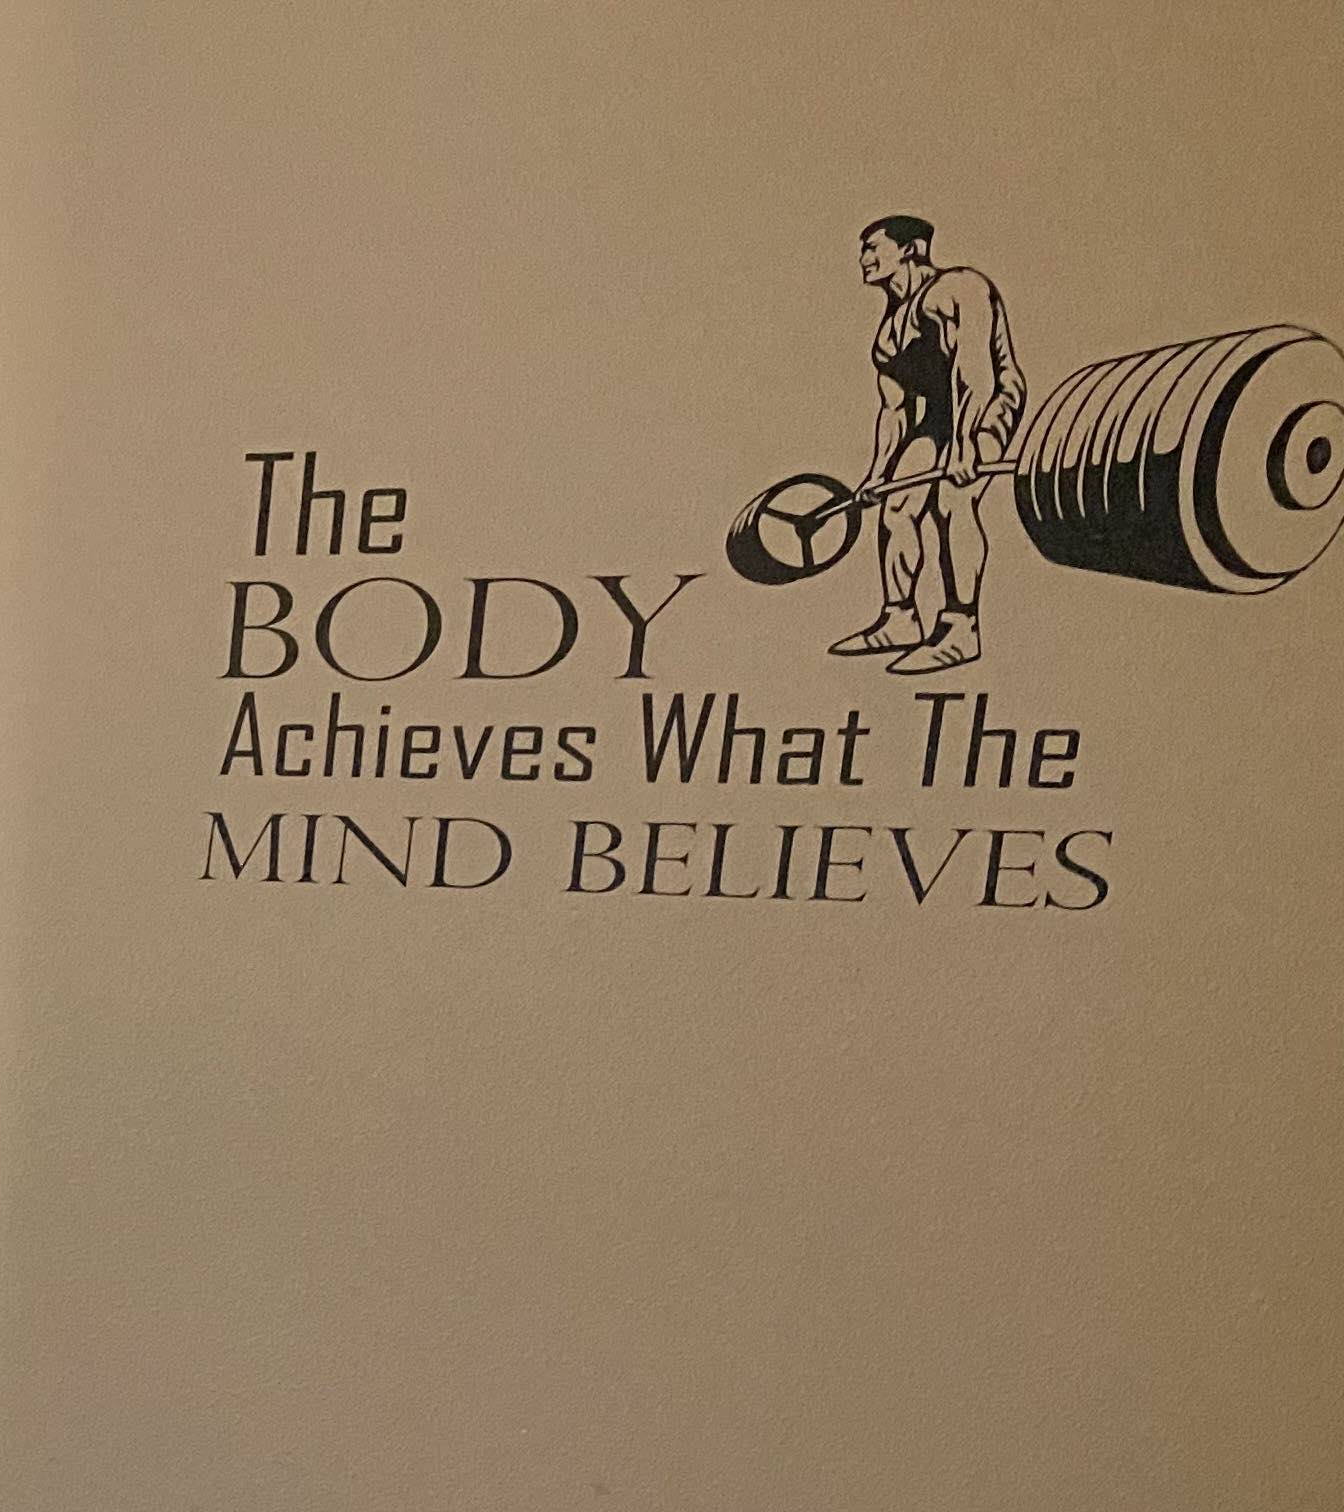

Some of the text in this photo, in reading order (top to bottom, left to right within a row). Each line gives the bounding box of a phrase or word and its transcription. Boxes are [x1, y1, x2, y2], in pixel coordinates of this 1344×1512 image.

[244, 451, 408, 557] The
[218, 572, 706, 682] BODY
[220, 691, 1081, 790] Achieves What The
[199, 812, 1115, 912] MIND BELIEVES
